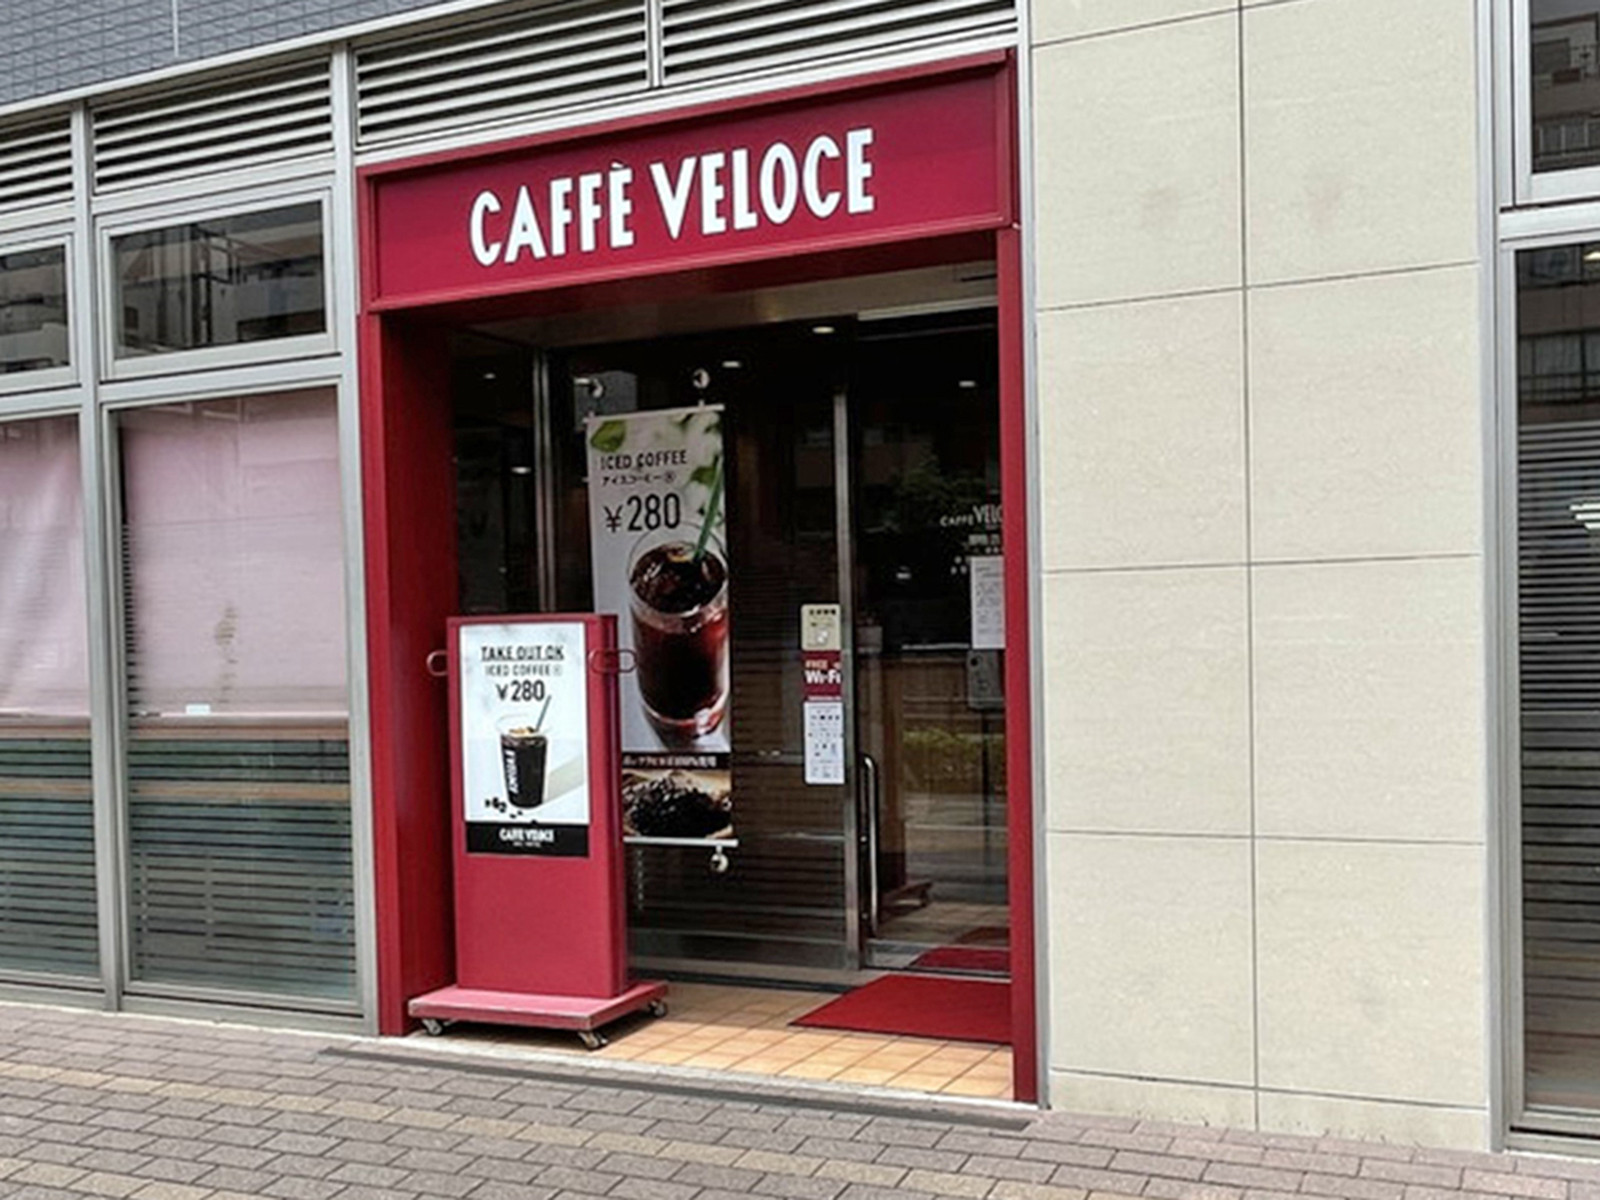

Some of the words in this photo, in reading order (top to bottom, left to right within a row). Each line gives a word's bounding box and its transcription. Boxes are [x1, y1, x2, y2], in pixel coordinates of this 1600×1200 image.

[470, 161, 635, 267] CAFFÈ
[649, 128, 875, 240] VELOCE
[600, 454, 632, 470] ICED
[637, 449, 688, 470] COFFEE
[603, 492, 681, 533] ¥280
[481, 645, 514, 661] TAKE
[516, 645, 543, 661] OUT
[485, 664, 509, 677] ICED
[512, 664, 551, 677] COFFEE
[804, 669, 842, 684] Wi-Fi
